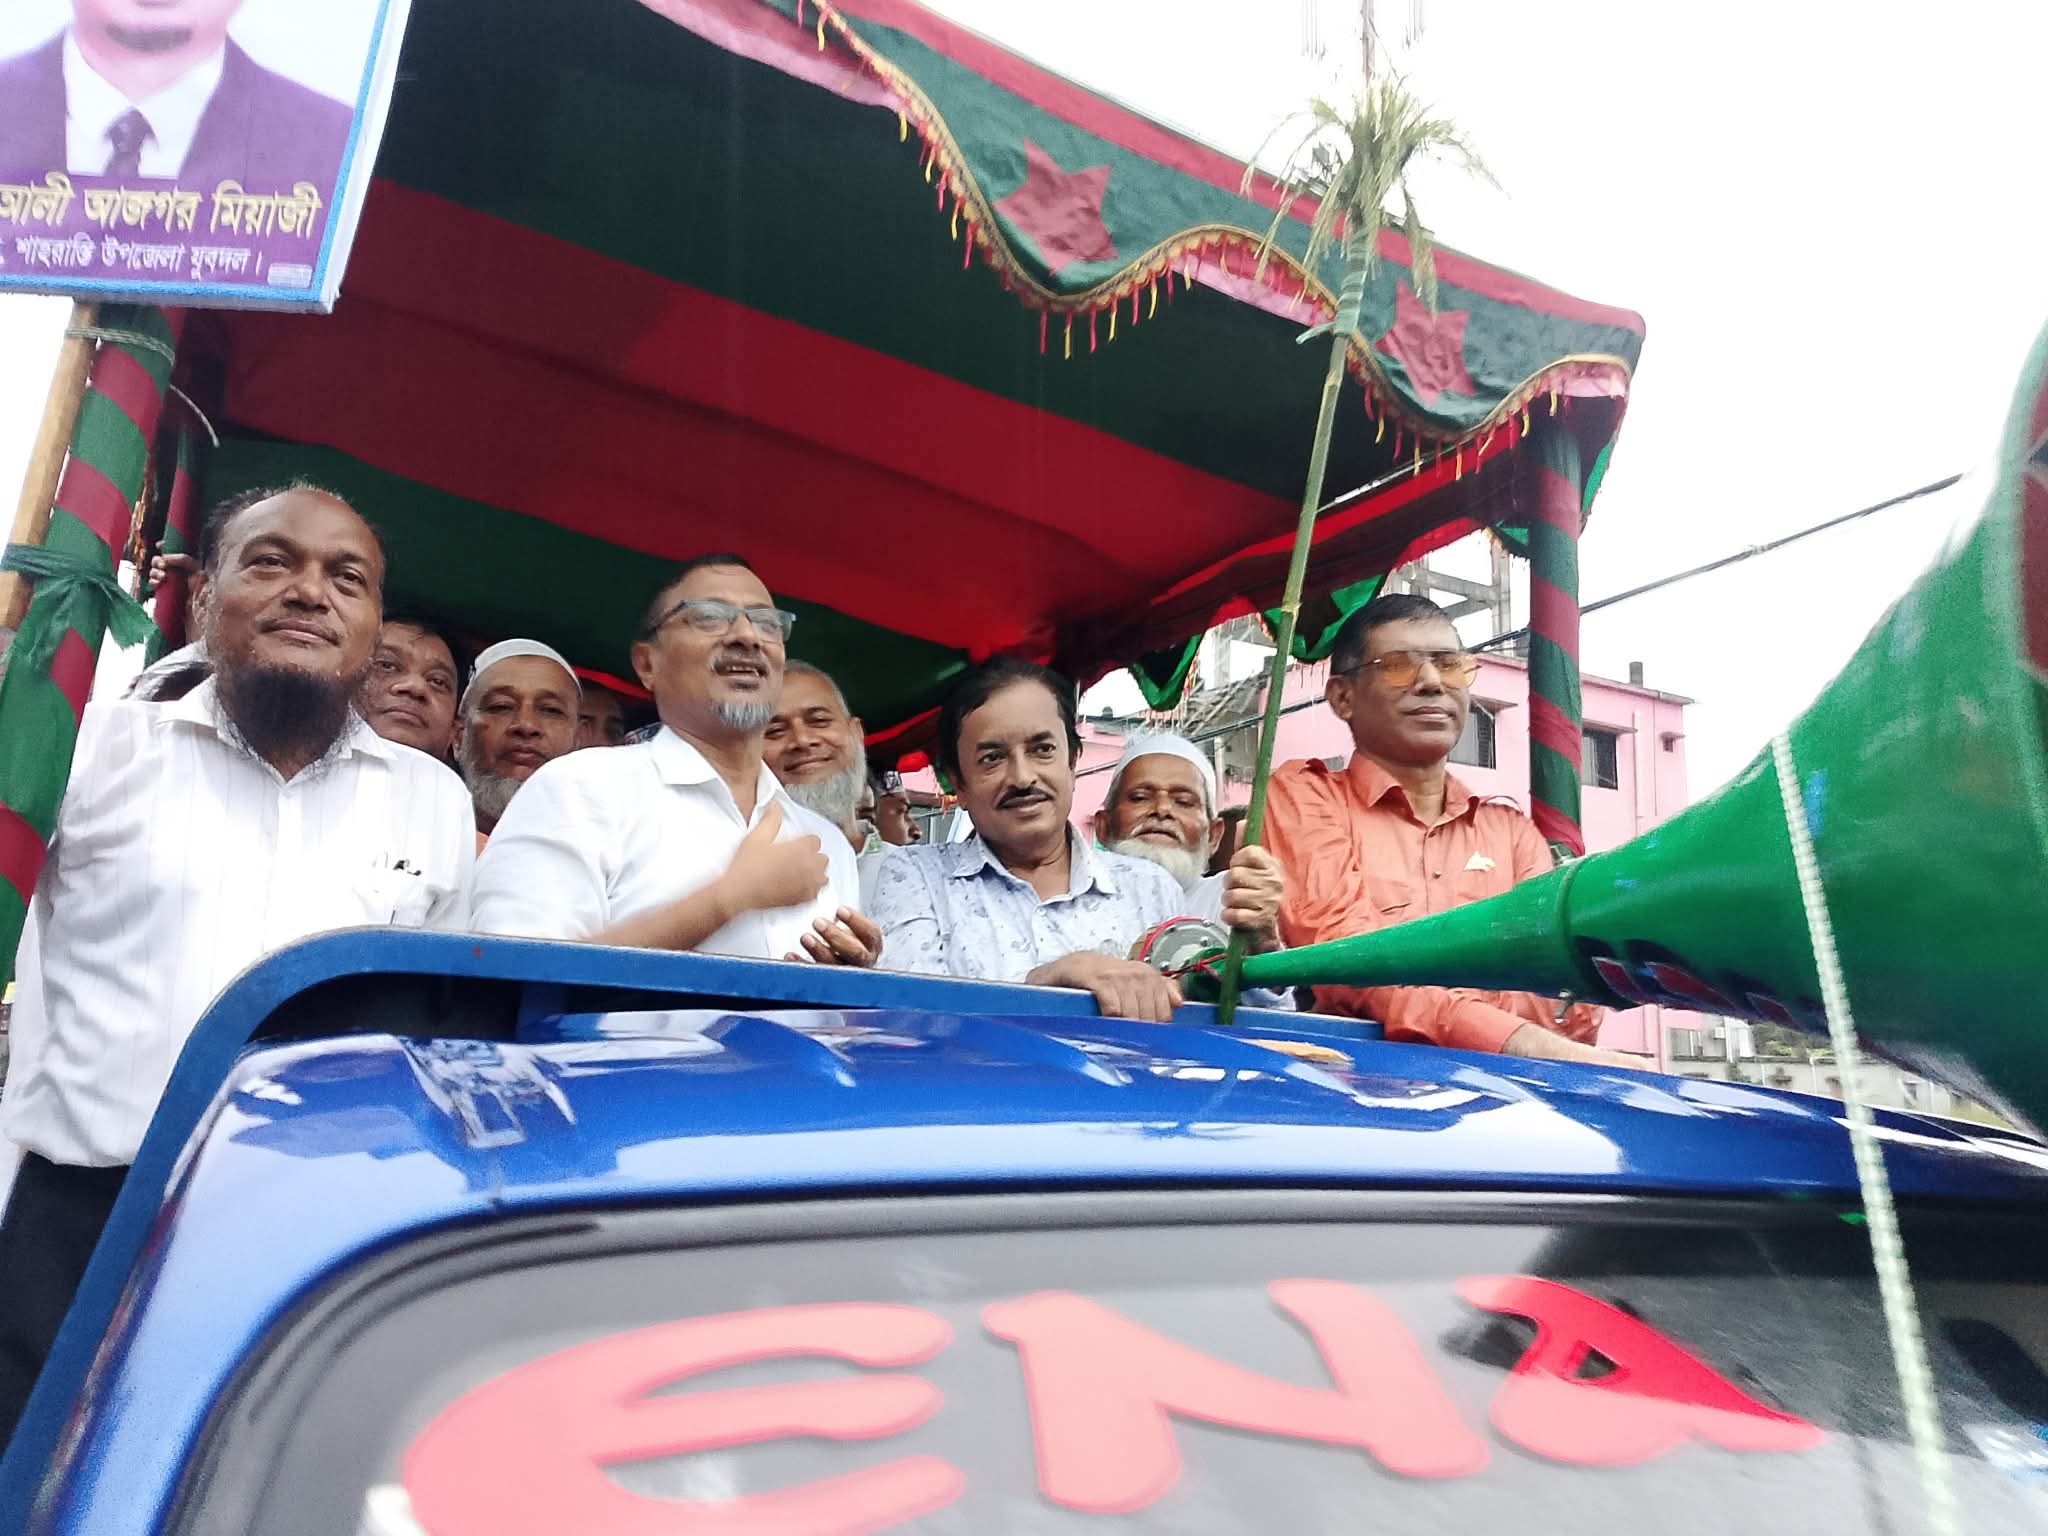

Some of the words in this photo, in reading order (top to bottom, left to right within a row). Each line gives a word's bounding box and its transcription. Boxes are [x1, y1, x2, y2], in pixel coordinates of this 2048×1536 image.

[84, 184, 202, 233] আজগর
[210, 179, 322, 240] মিয়াজী
[101, 233, 185, 273] উপজেলা
[402, 1276, 1824, 1536] ENA
